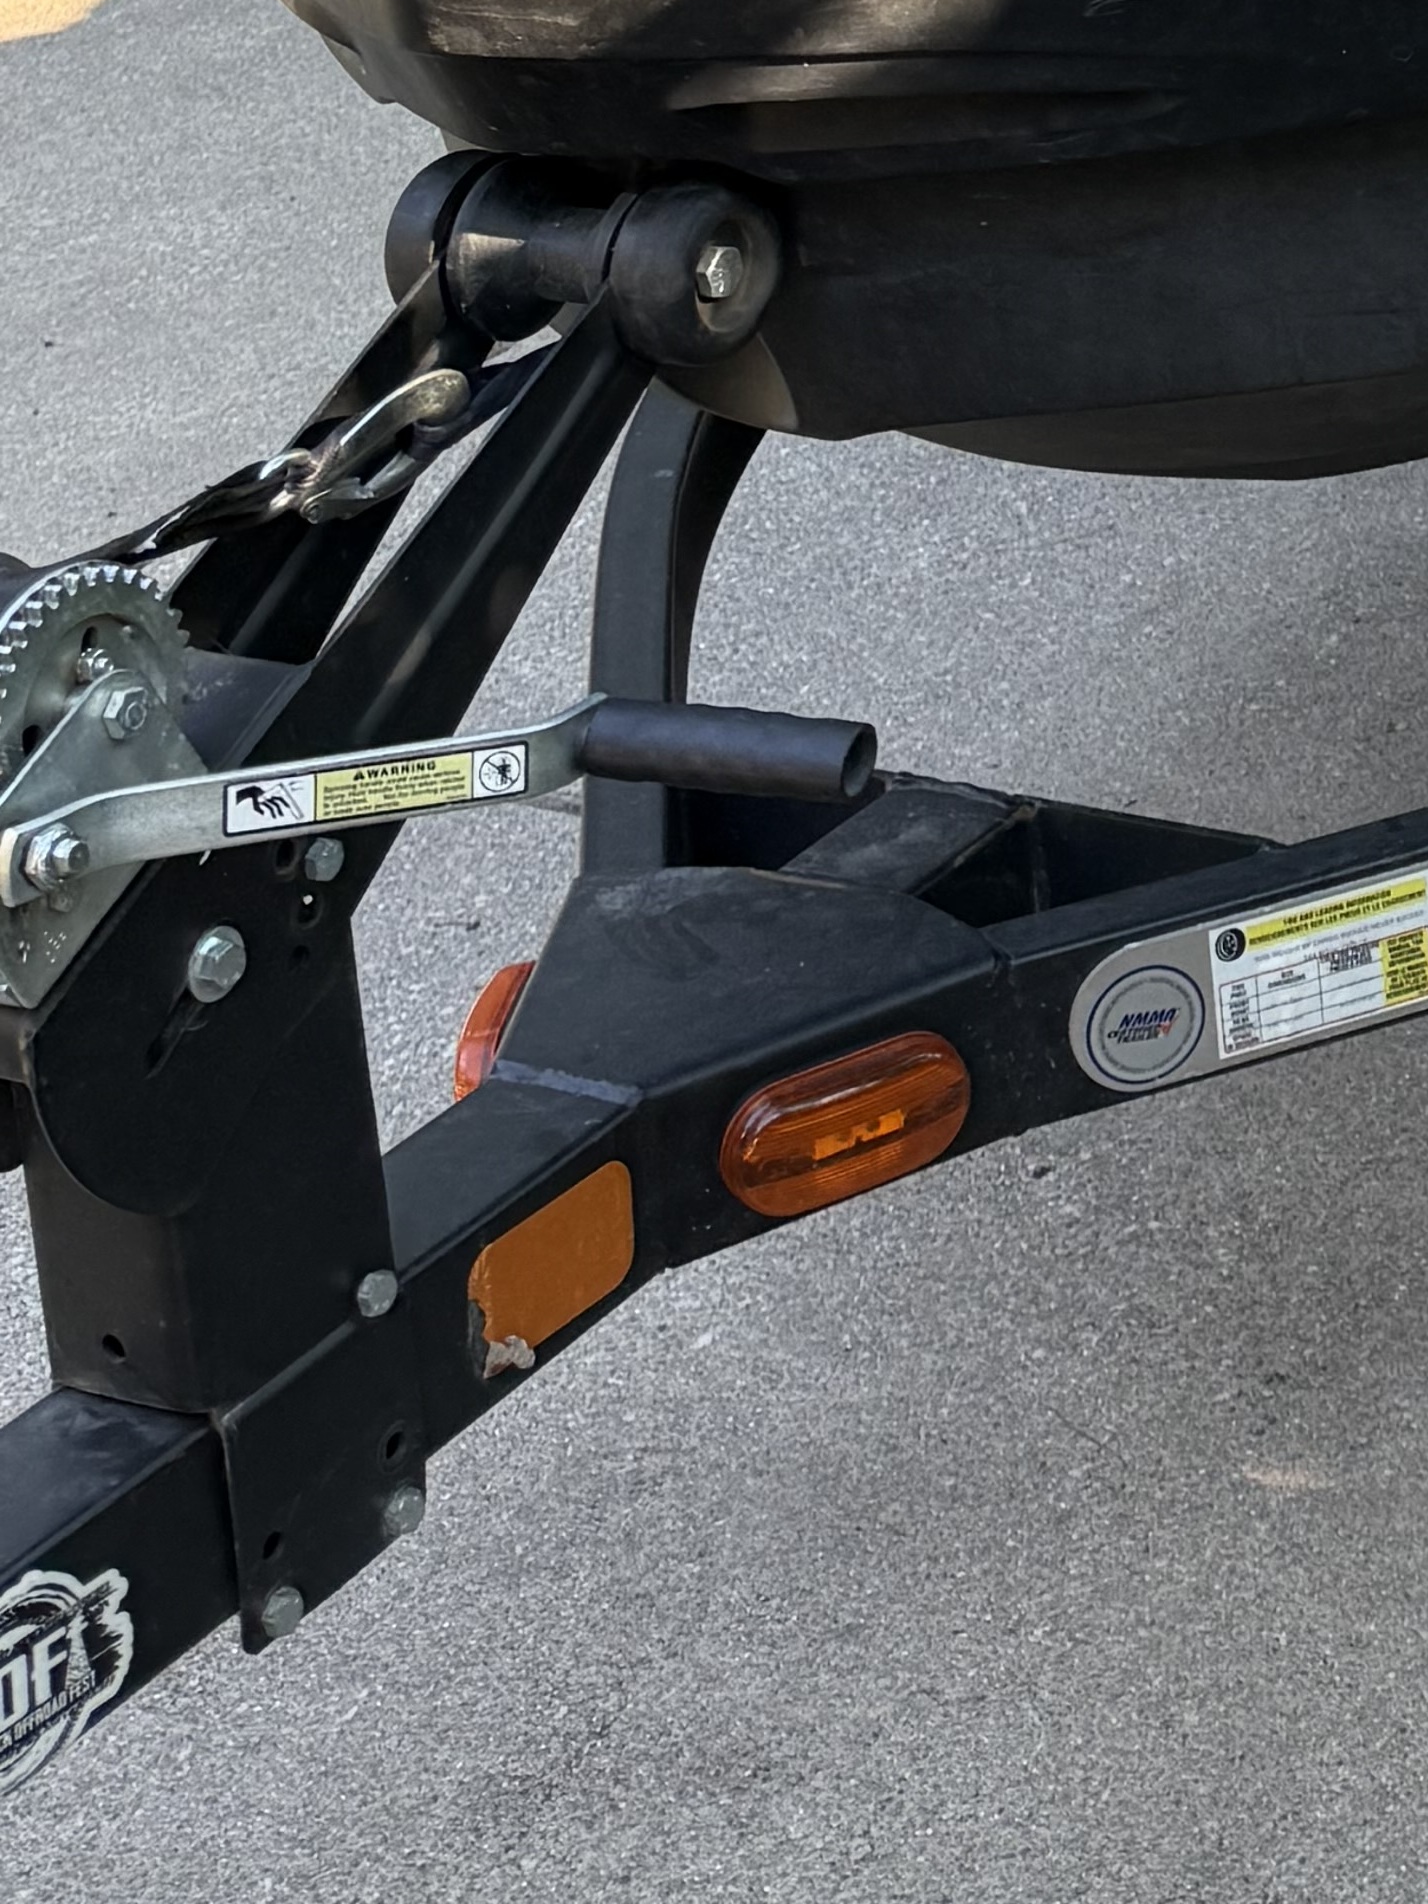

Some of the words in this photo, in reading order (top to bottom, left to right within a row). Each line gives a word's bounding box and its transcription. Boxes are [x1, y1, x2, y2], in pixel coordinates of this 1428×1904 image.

[366, 759, 437, 779] WARNING
[13, 1690, 67, 1741] OFFROAD
[68, 1670, 97, 1704] FEST
